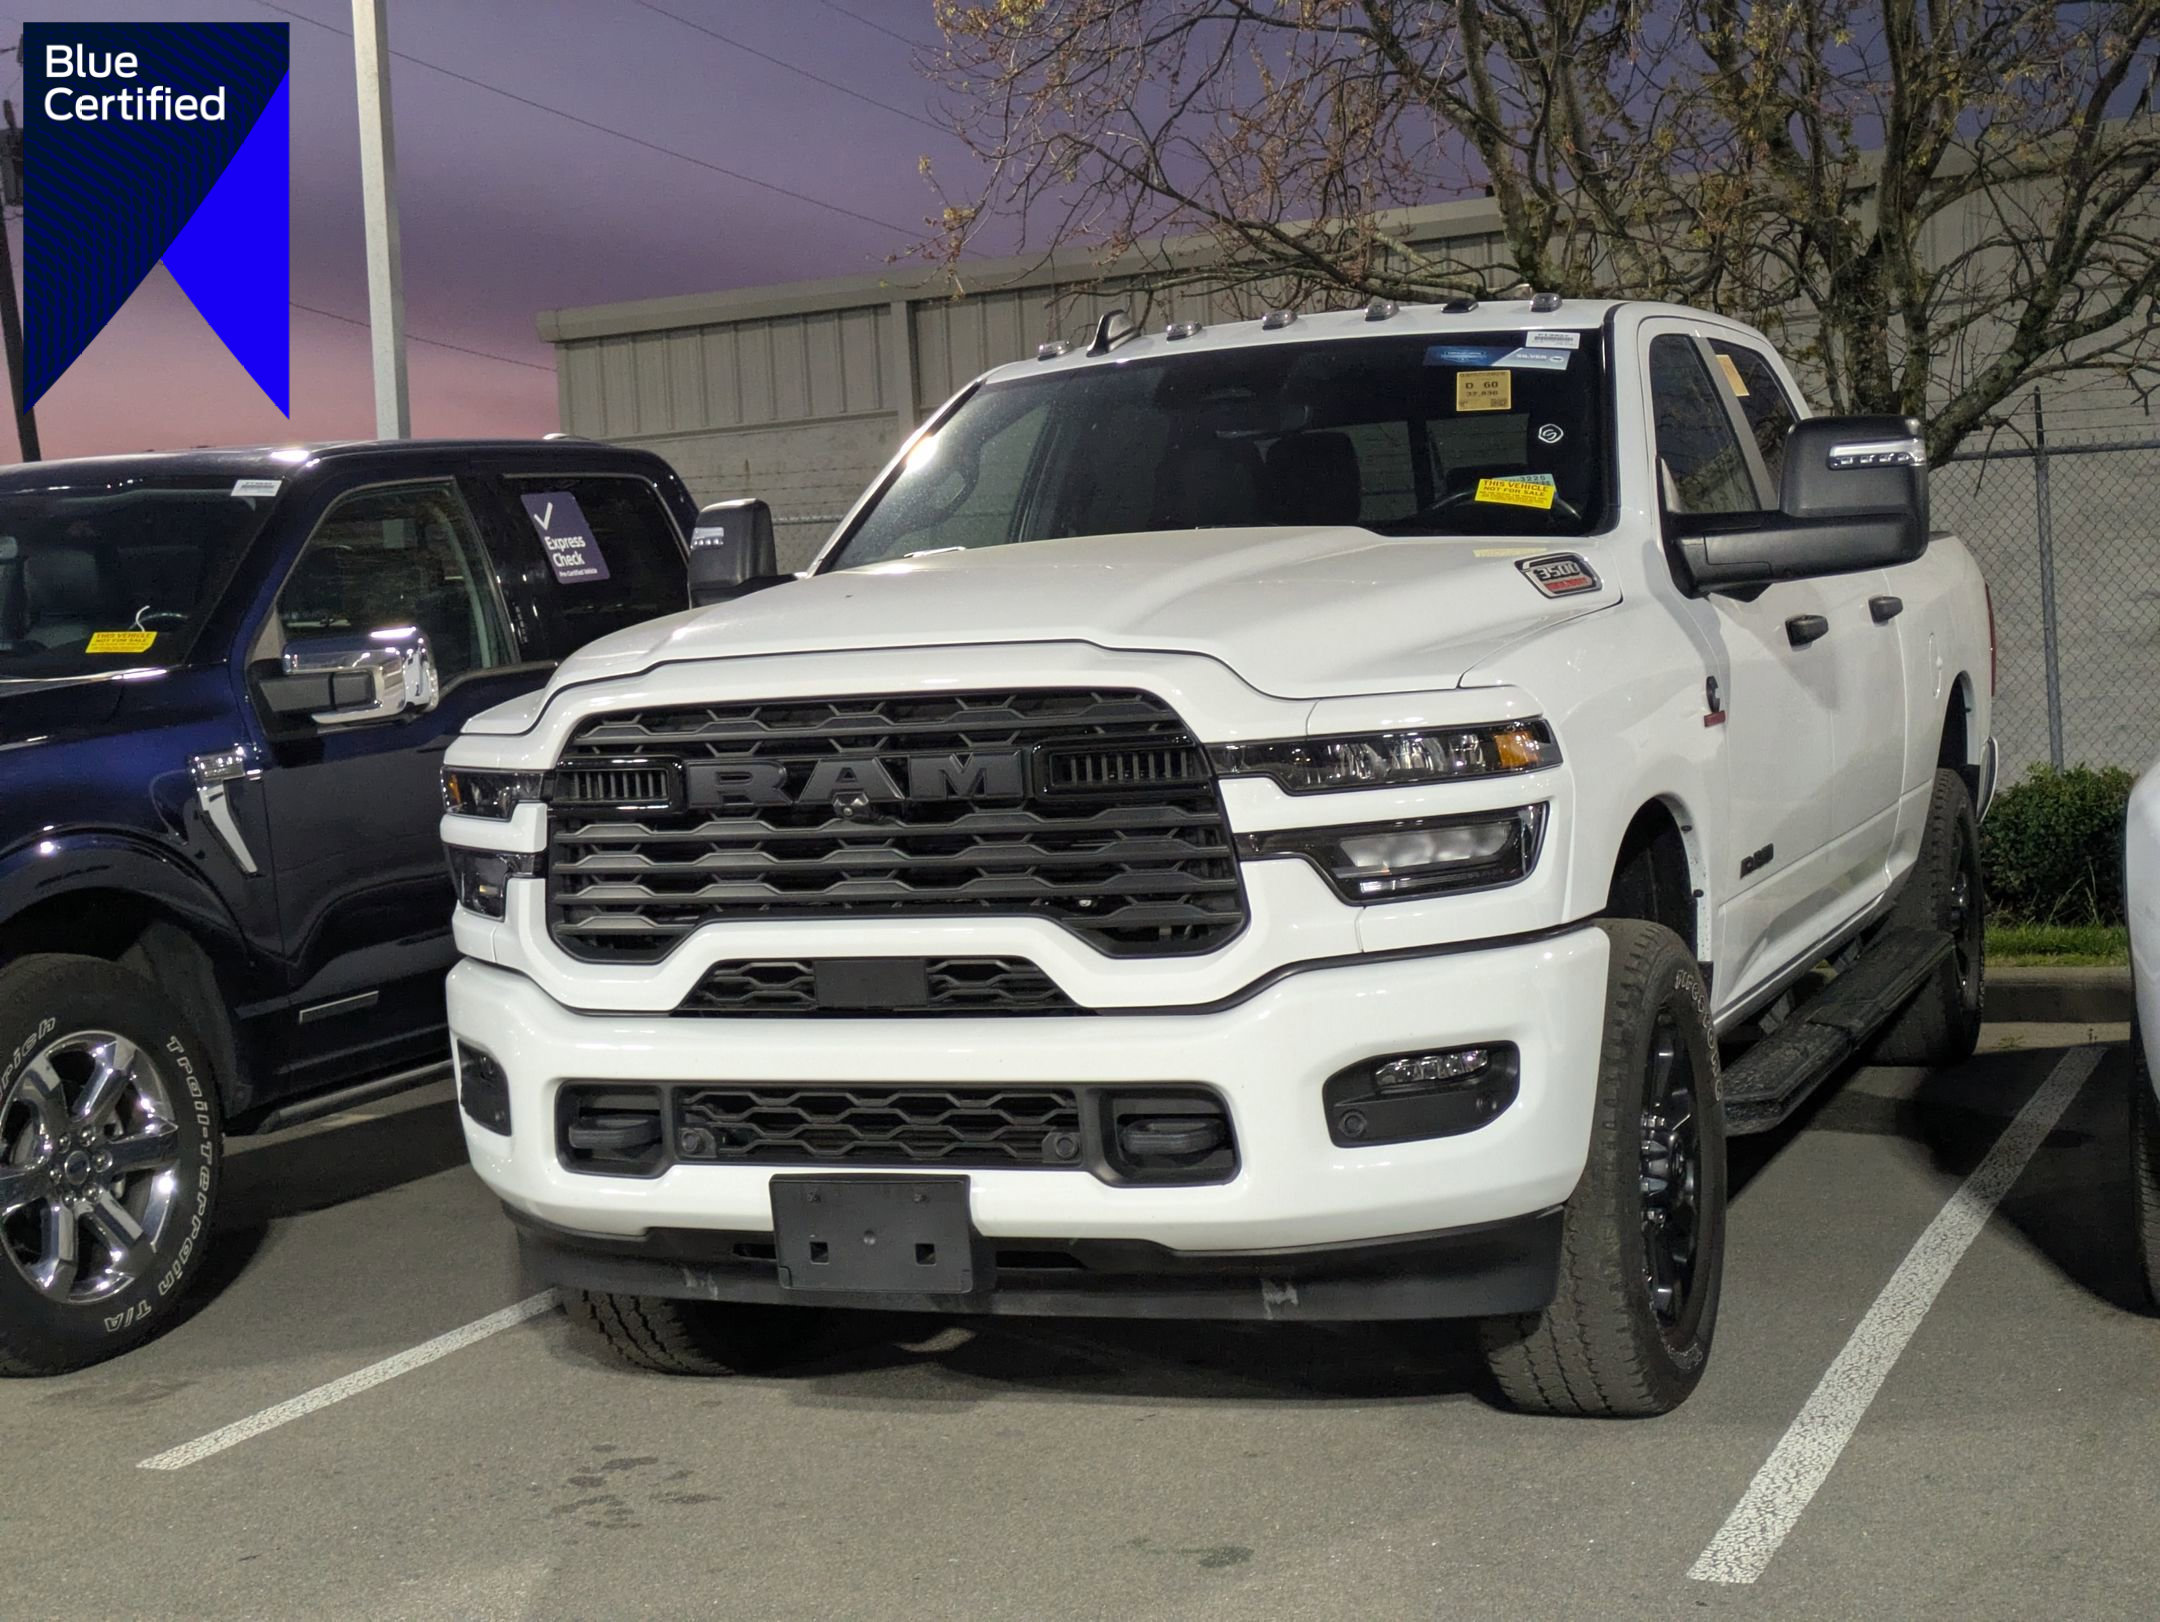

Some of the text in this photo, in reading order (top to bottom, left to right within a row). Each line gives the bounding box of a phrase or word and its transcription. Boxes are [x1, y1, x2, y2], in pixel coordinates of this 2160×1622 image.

[1483, 479, 1505, 487] THIS
[1508, 482, 1548, 492] VEHICLE
[544, 535, 586, 552] Express
[552, 550, 586, 567] Check
[1536, 563, 1580, 580] 3500
[684, 748, 1026, 807] RAM
[158, 1036, 213, 1296] Trail-Terrain
